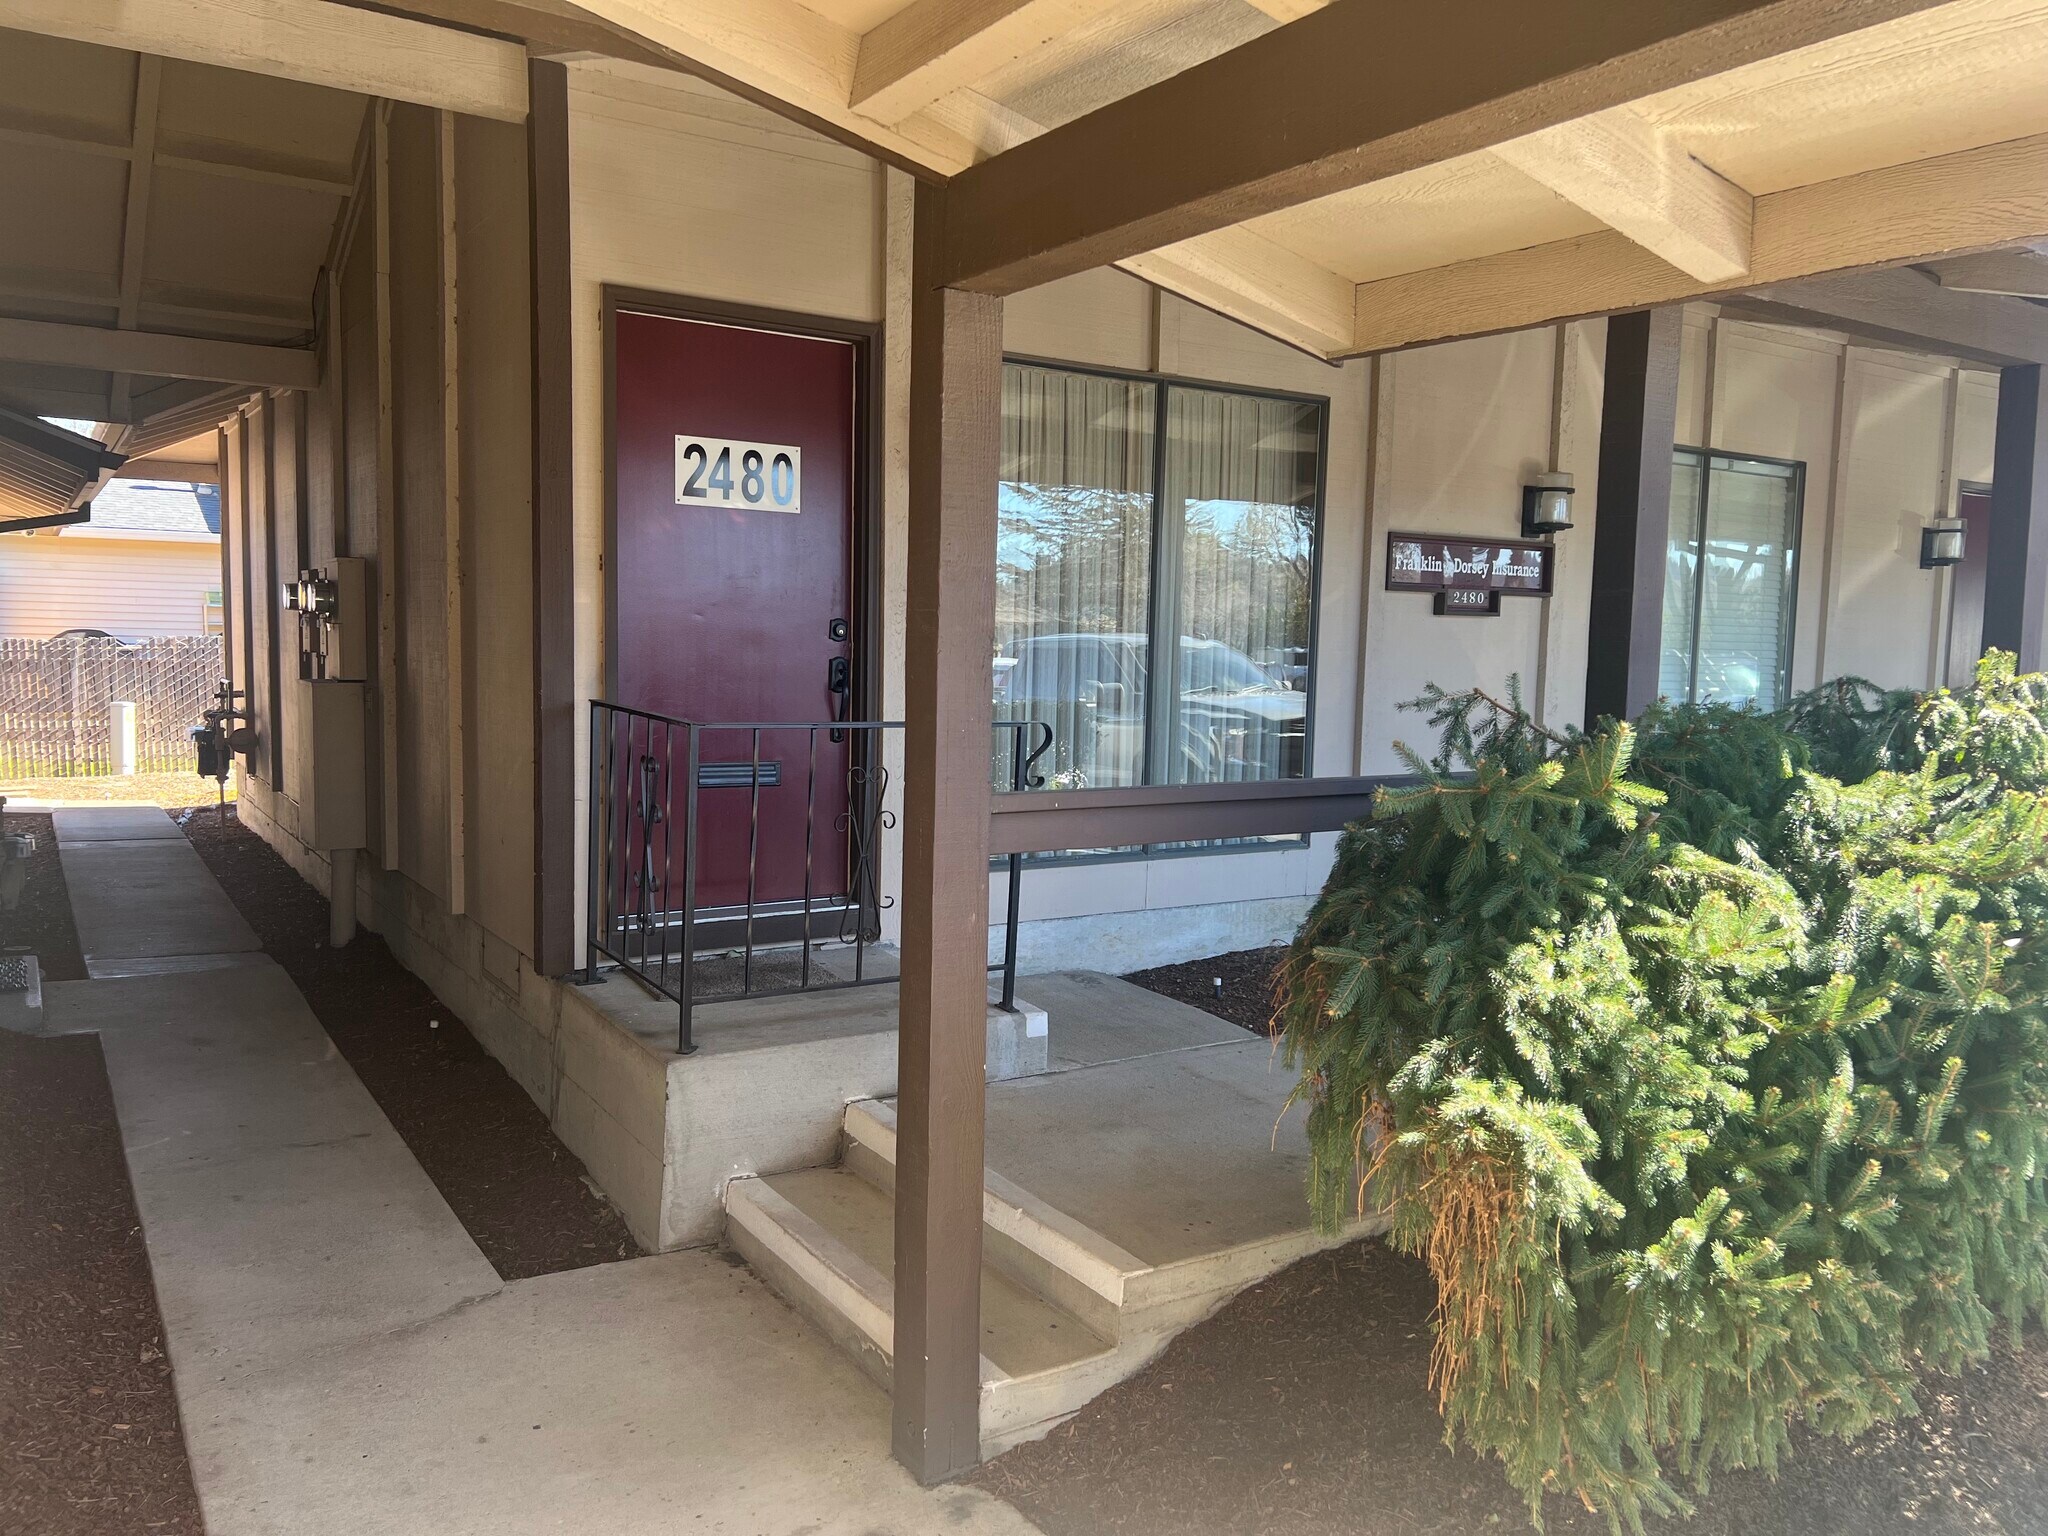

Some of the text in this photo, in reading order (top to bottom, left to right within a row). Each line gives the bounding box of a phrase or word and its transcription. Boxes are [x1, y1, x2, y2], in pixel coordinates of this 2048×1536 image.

[682, 443, 795, 506] 2480
[1453, 557, 1489, 579] Dorsey
[1491, 560, 1540, 578] Insurance
[1453, 591, 1485, 604] 2480
